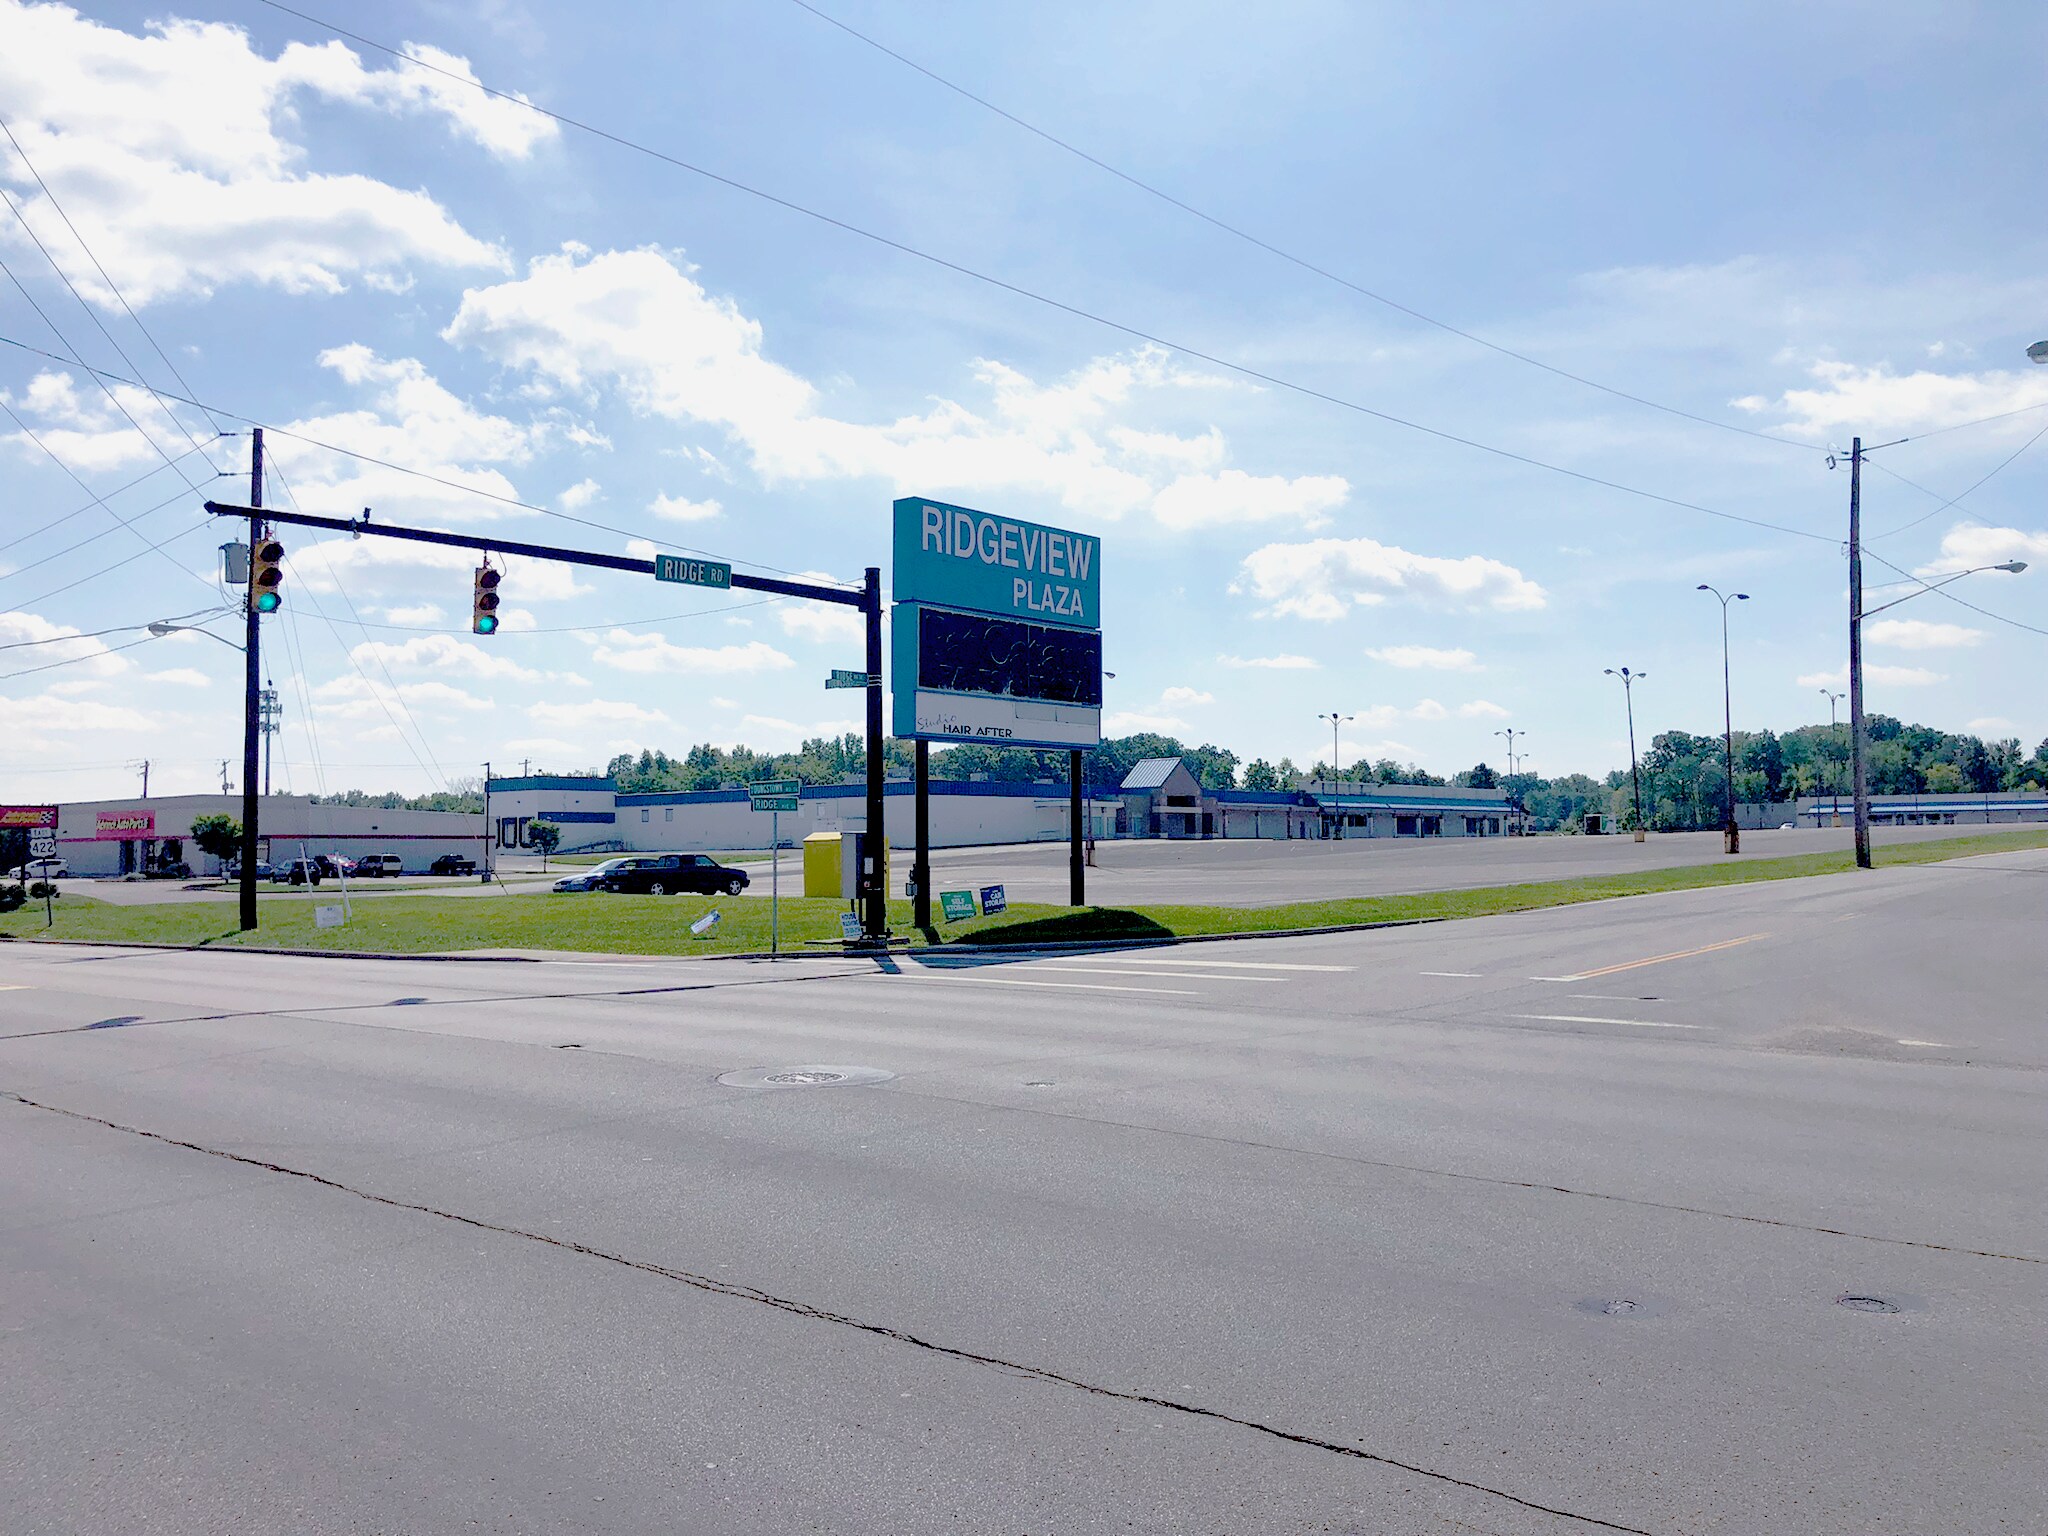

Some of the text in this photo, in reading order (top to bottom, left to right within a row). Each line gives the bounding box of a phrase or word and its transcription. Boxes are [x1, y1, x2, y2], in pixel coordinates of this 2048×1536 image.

[921, 505, 1093, 581] RIDGEVIEW
[665, 559, 723, 582] RIDGE RD
[1013, 577, 1084, 618] PLAZA
[917, 713, 957, 730] Studio
[943, 723, 1013, 738] HAIR AFTER
[756, 799, 778, 809] RIDGE
[32, 841, 54, 853] 422
[945, 903, 973, 912] STORAGE
